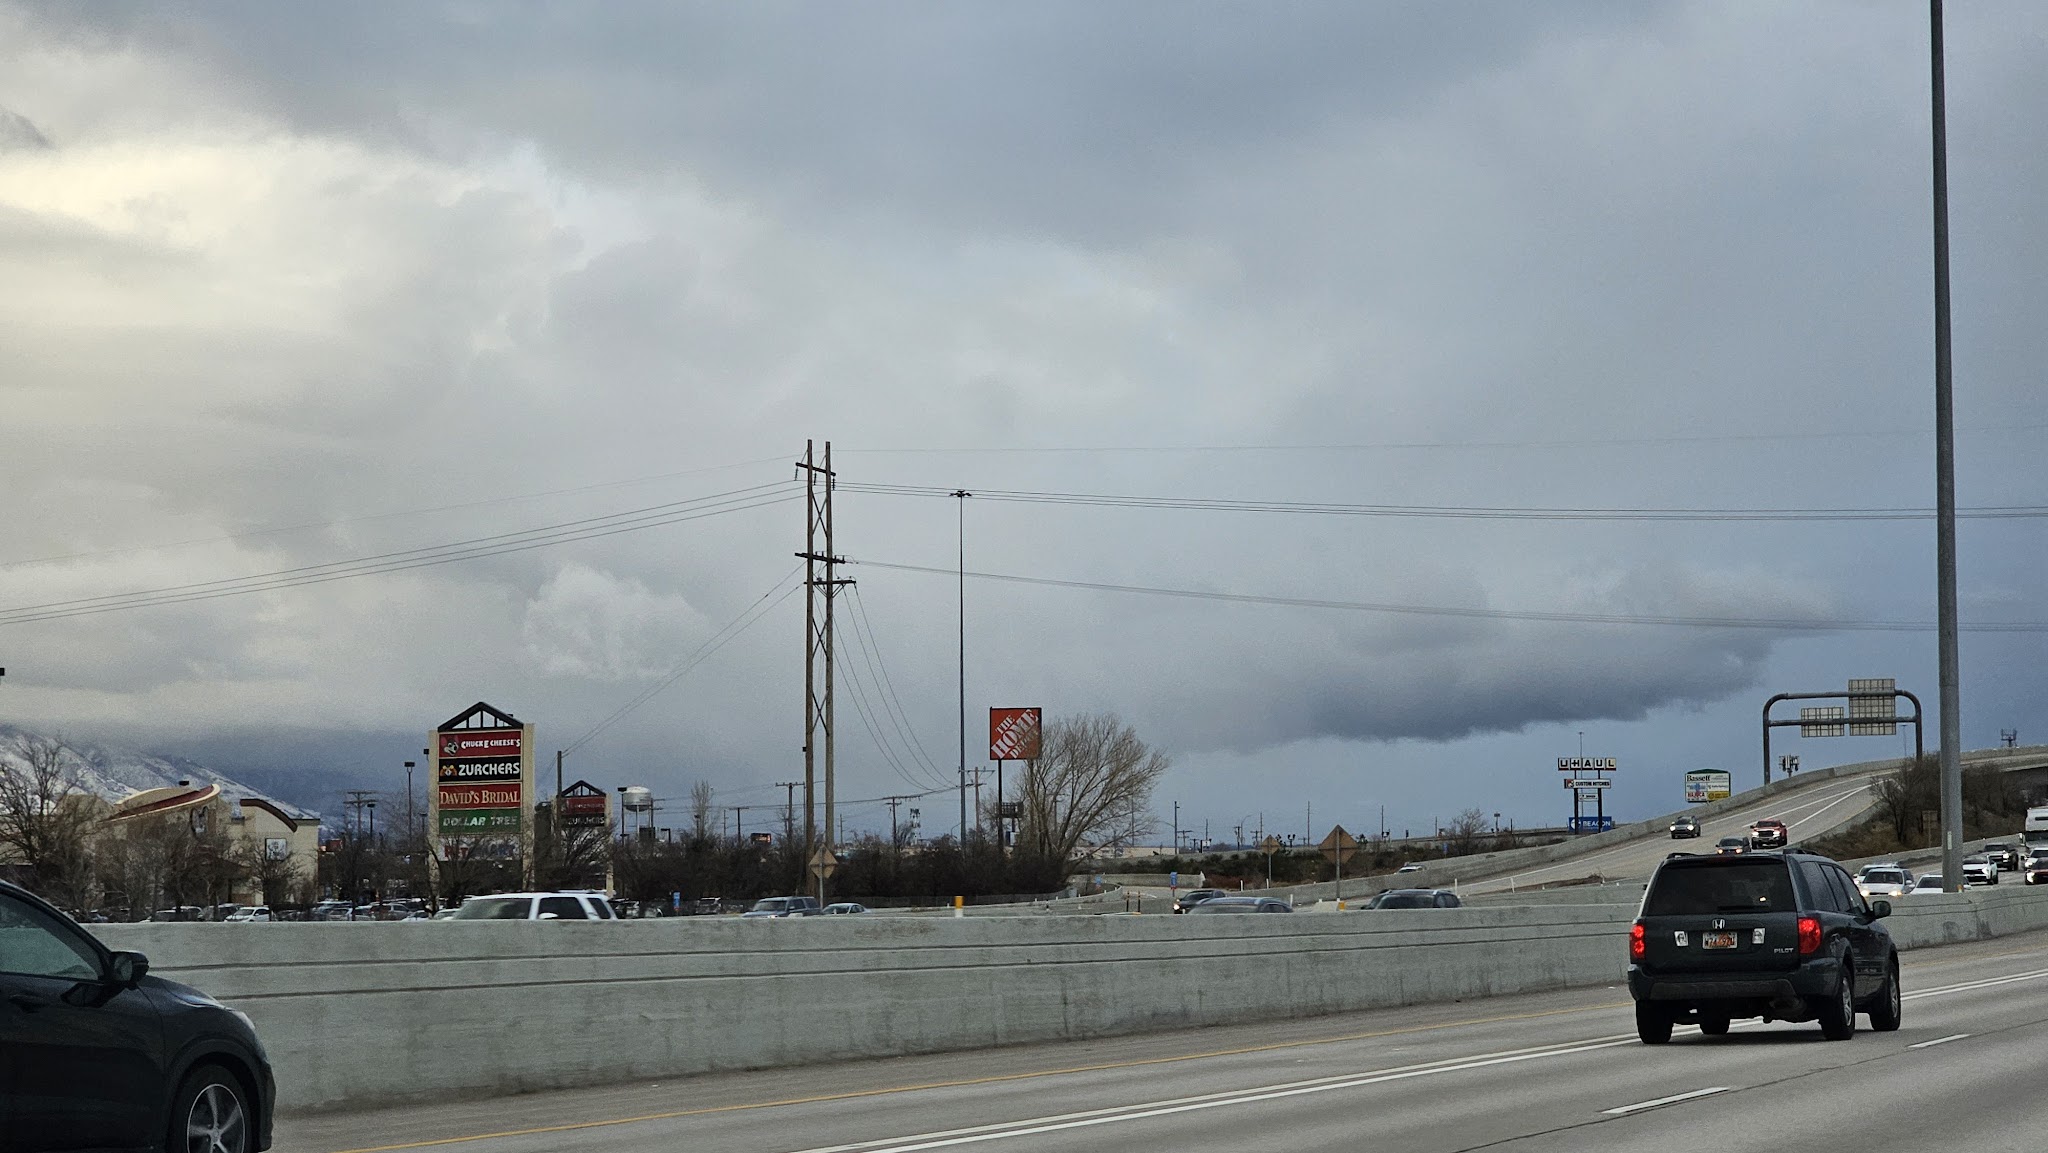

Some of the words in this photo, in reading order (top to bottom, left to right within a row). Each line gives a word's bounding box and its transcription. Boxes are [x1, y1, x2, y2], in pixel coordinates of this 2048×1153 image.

[995, 715, 1015, 734] THE
[991, 709, 1039, 759] HOME
[461, 740, 483, 749] CHUCK
[484, 740, 489, 748] E
[490, 739, 520, 747] CHEESE'S
[458, 762, 520, 776] ZURCHERS
[440, 791, 480, 804] DAVID'S
[481, 790, 520, 804] BRIDAL
